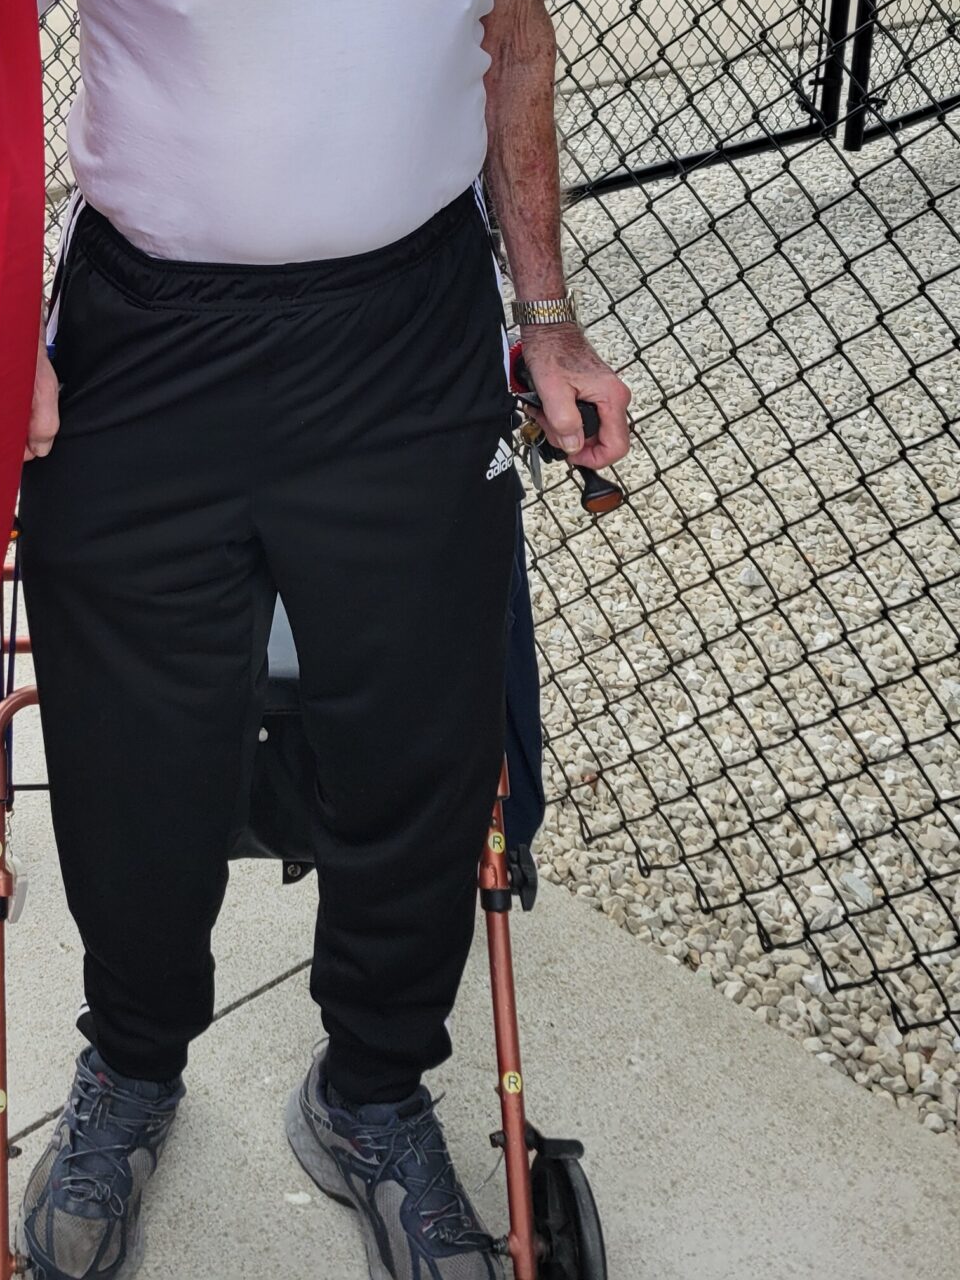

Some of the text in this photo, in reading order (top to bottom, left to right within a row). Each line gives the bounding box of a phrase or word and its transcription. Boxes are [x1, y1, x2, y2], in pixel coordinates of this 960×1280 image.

[486, 456, 513, 480] adida
[493, 835, 503, 849] R
[508, 1075, 519, 1090] R
